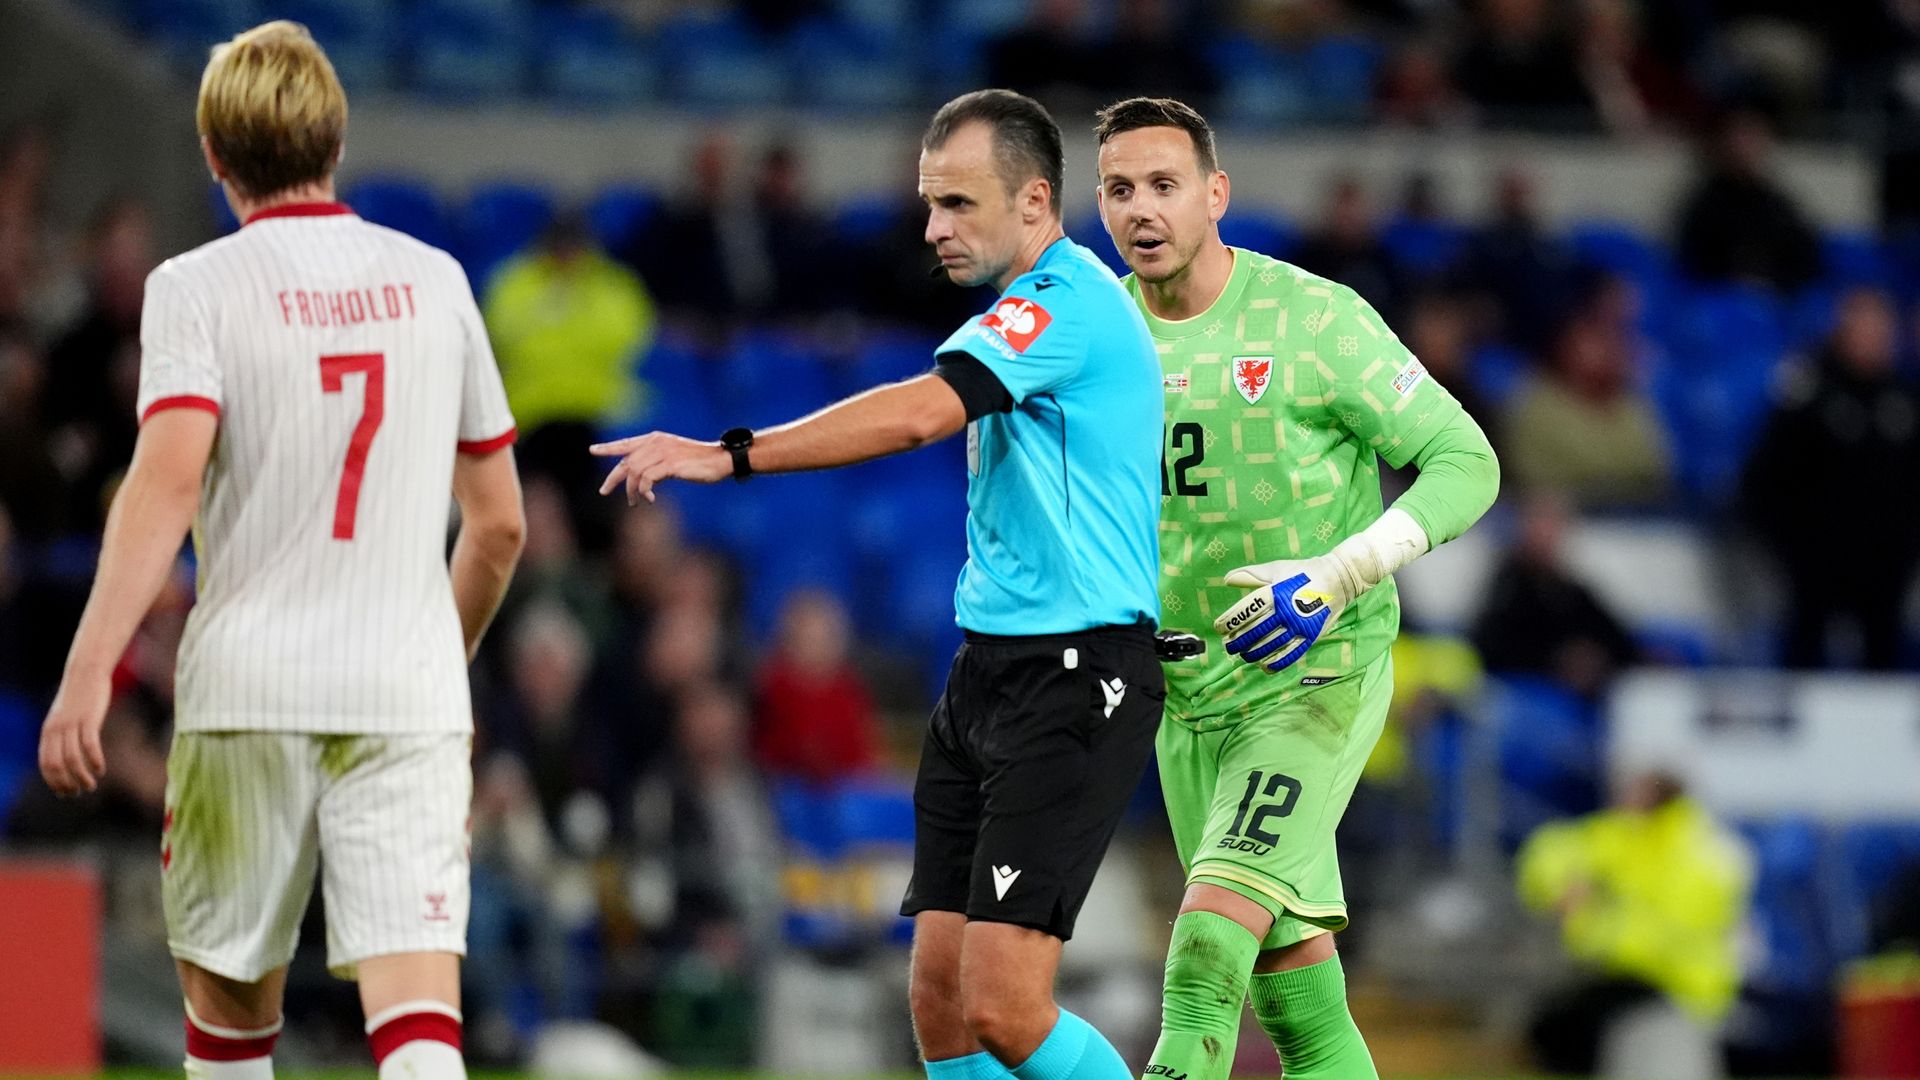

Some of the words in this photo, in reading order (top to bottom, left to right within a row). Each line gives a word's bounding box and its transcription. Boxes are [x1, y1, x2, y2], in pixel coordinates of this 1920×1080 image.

[278, 284, 416, 327] FROHOLDT
[319, 353, 385, 541] 7
[1226, 597, 1266, 631] reusch
[1225, 770, 1303, 848] 12
[1217, 838, 1271, 856] SUDU
